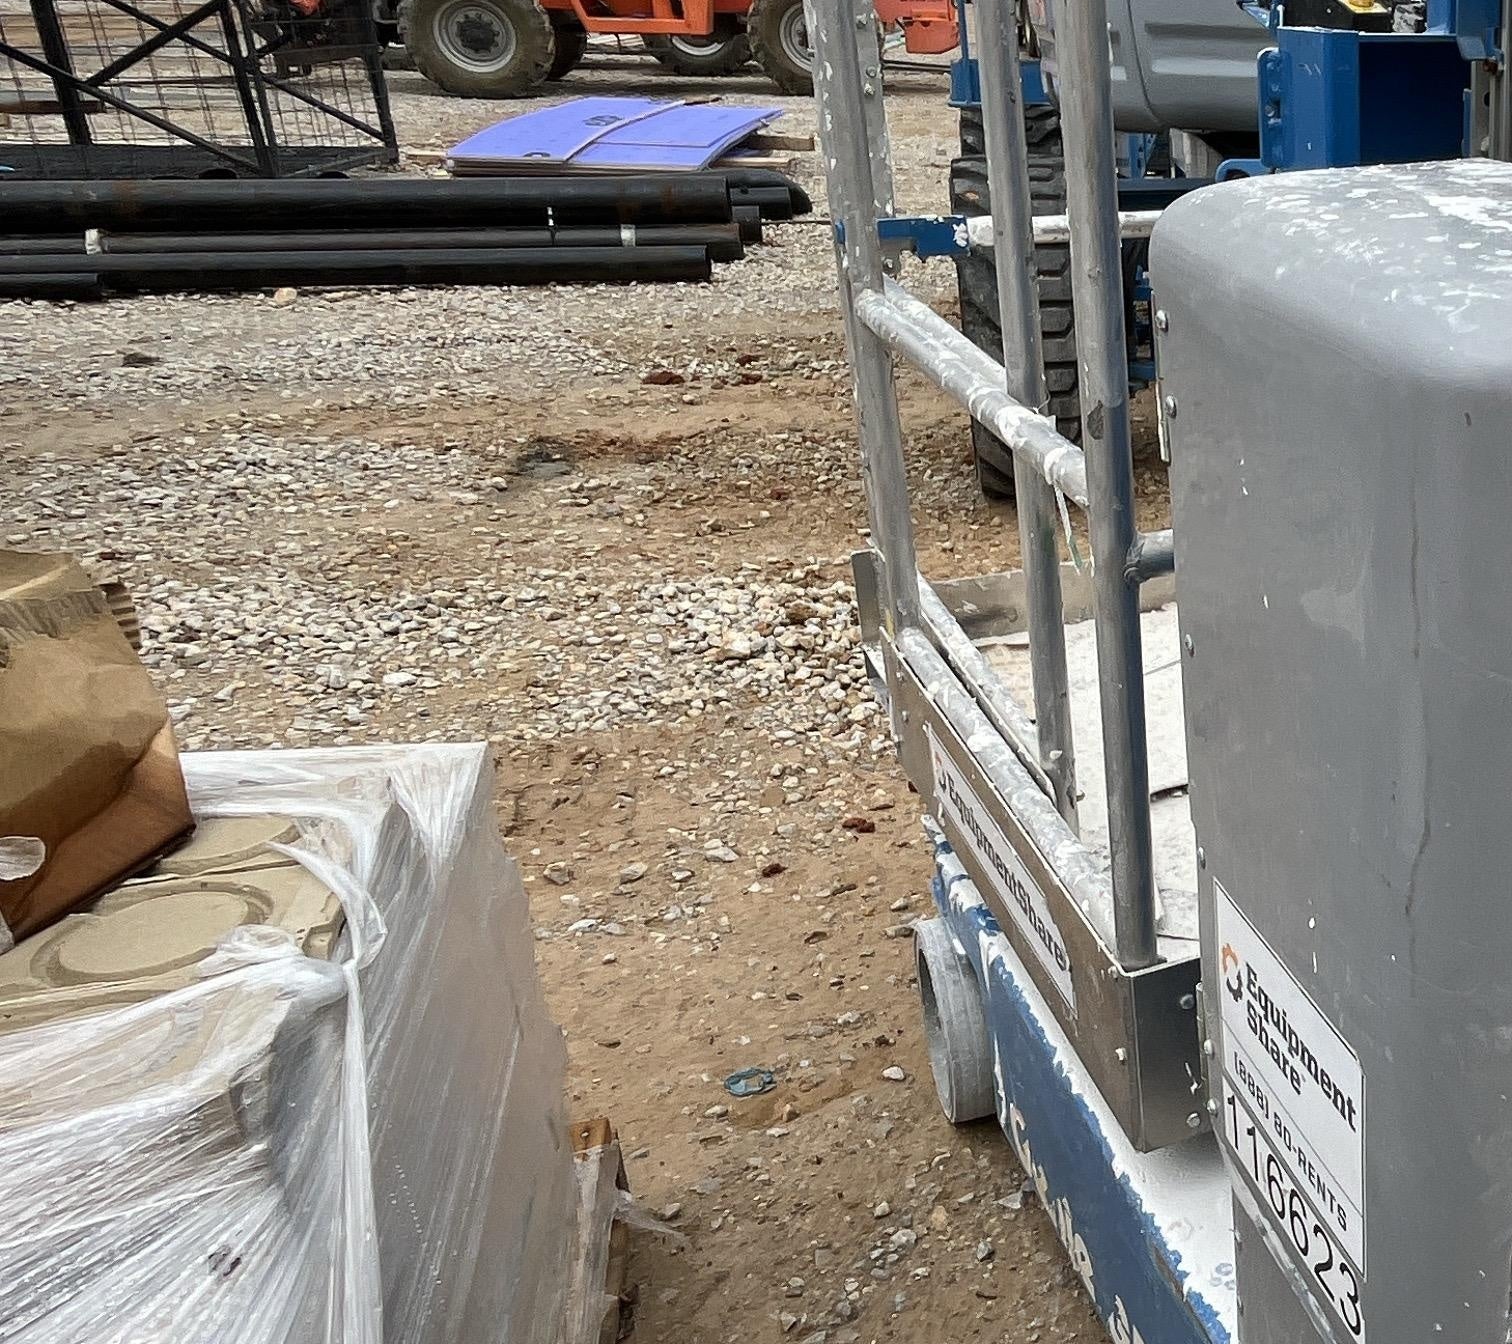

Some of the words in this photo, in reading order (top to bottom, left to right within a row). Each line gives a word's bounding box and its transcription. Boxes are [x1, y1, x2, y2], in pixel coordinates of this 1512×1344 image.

[948, 771, 1067, 972] EquipmentShare
[1246, 960, 1357, 1133] Equipment
[1246, 1002, 1302, 1096] Share
[1227, 1094, 1362, 1338] 116623
[1233, 1051, 1270, 1122] (888)
[1273, 1115, 1348, 1232] 80-RENTS
